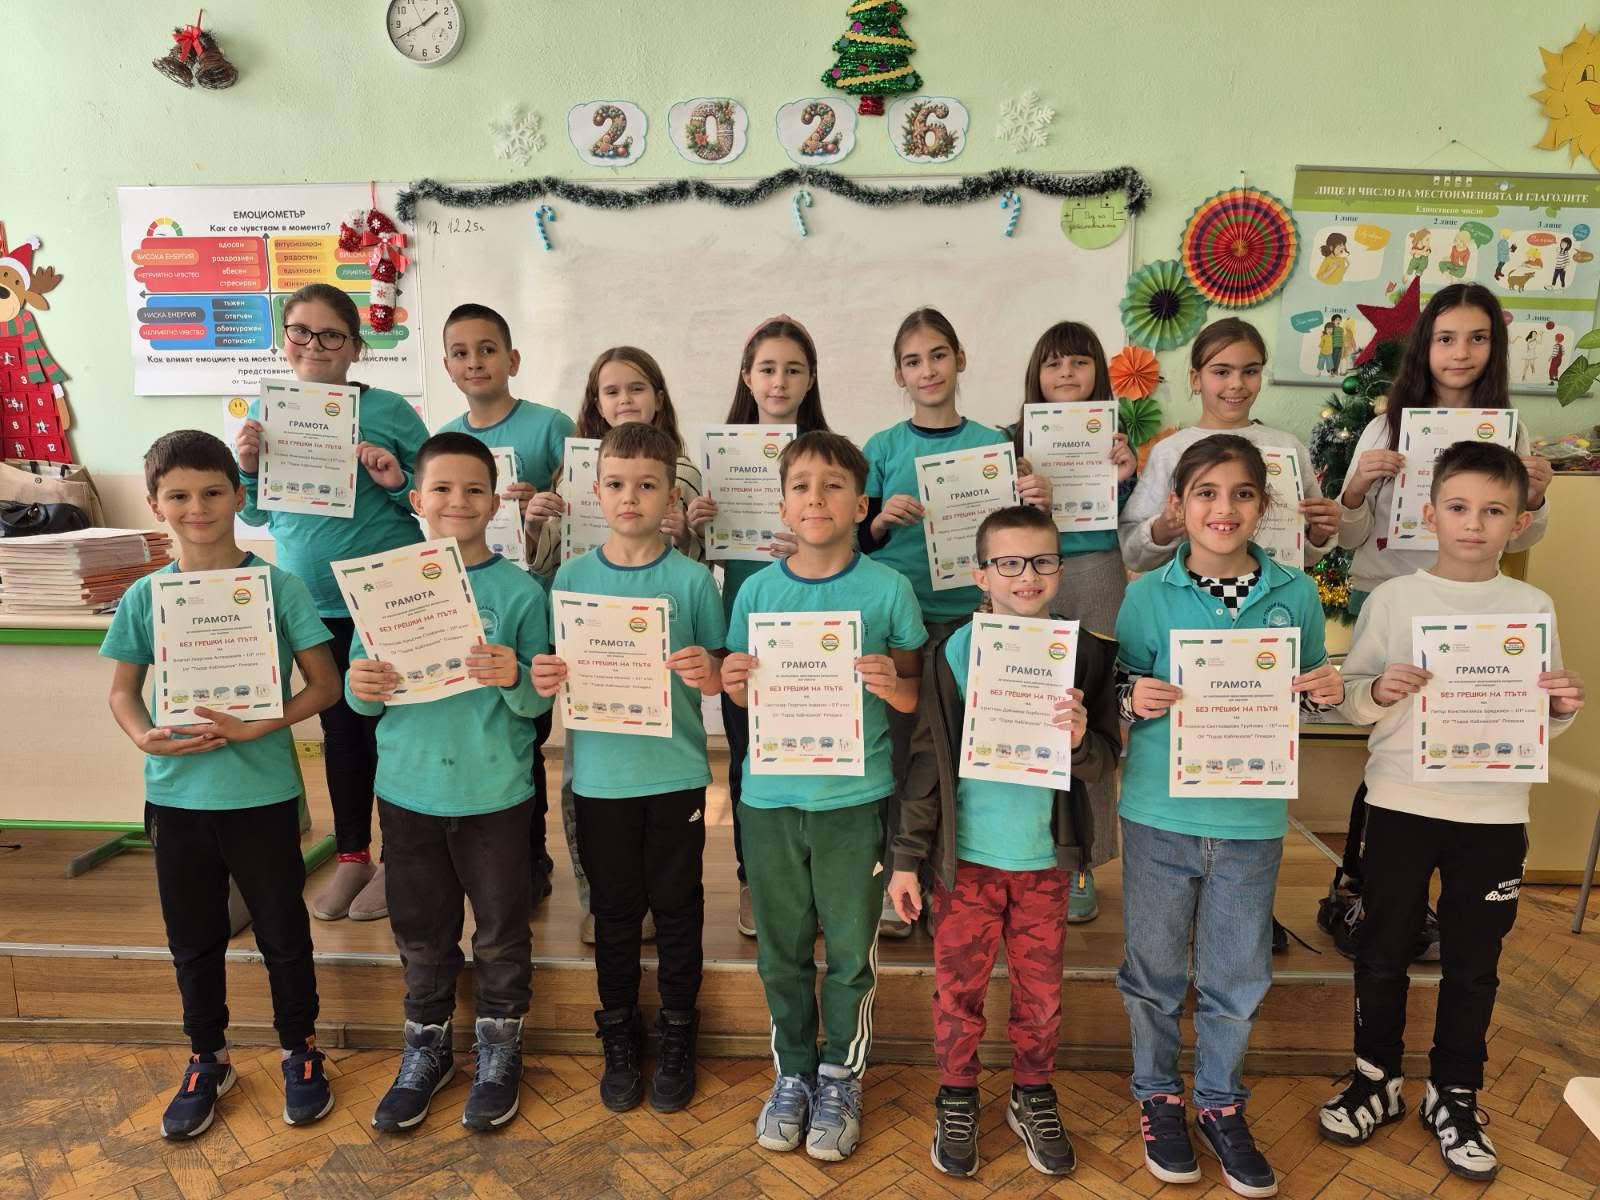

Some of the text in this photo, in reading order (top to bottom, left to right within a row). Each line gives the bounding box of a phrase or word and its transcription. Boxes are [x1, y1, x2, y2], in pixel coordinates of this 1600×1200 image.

[397, 6, 407, 15] 10
[422, 49, 427, 57] 6
[592, 102, 957, 160] 2 0 2 6
[1315, 186, 1590, 203] ЛИЦЕ И ЧИСЛО НА МЕСТОИМЕНИЯТА И ГЛАГОЛИТЕ
[233, 210, 306, 220] ЕМОЦИОМЕТЪР
[240, 226, 279, 234] чувствам
[289, 222, 331, 231] момента?
[21, 376, 27, 384] 3
[37, 398, 43, 406] 6
[12, 421, 19, 430] 8
[289, 420, 329, 430] ГРАМОТА
[47, 443, 56, 452] 12
[1052, 441, 1090, 449] ГРАМОТА
[950, 488, 990, 500] ГРАМОТА
[385, 590, 435, 610] ГРАМОТА
[192, 614, 241, 625] ГРАМОТА
[194, 639, 222, 647] ГРЕШКИ
[589, 638, 636, 648] ГРАМОТА
[781, 661, 828, 669] ГРАМОТА
[1005, 665, 1053, 677] ГРАМОТА
[1455, 666, 1510, 674] ГРАМОТА
[1210, 680, 1262, 689] ГРАМОТА
[1004, 690, 1032, 698] ГРЕШКИ
[1485, 887, 1520, 901] Brookly
